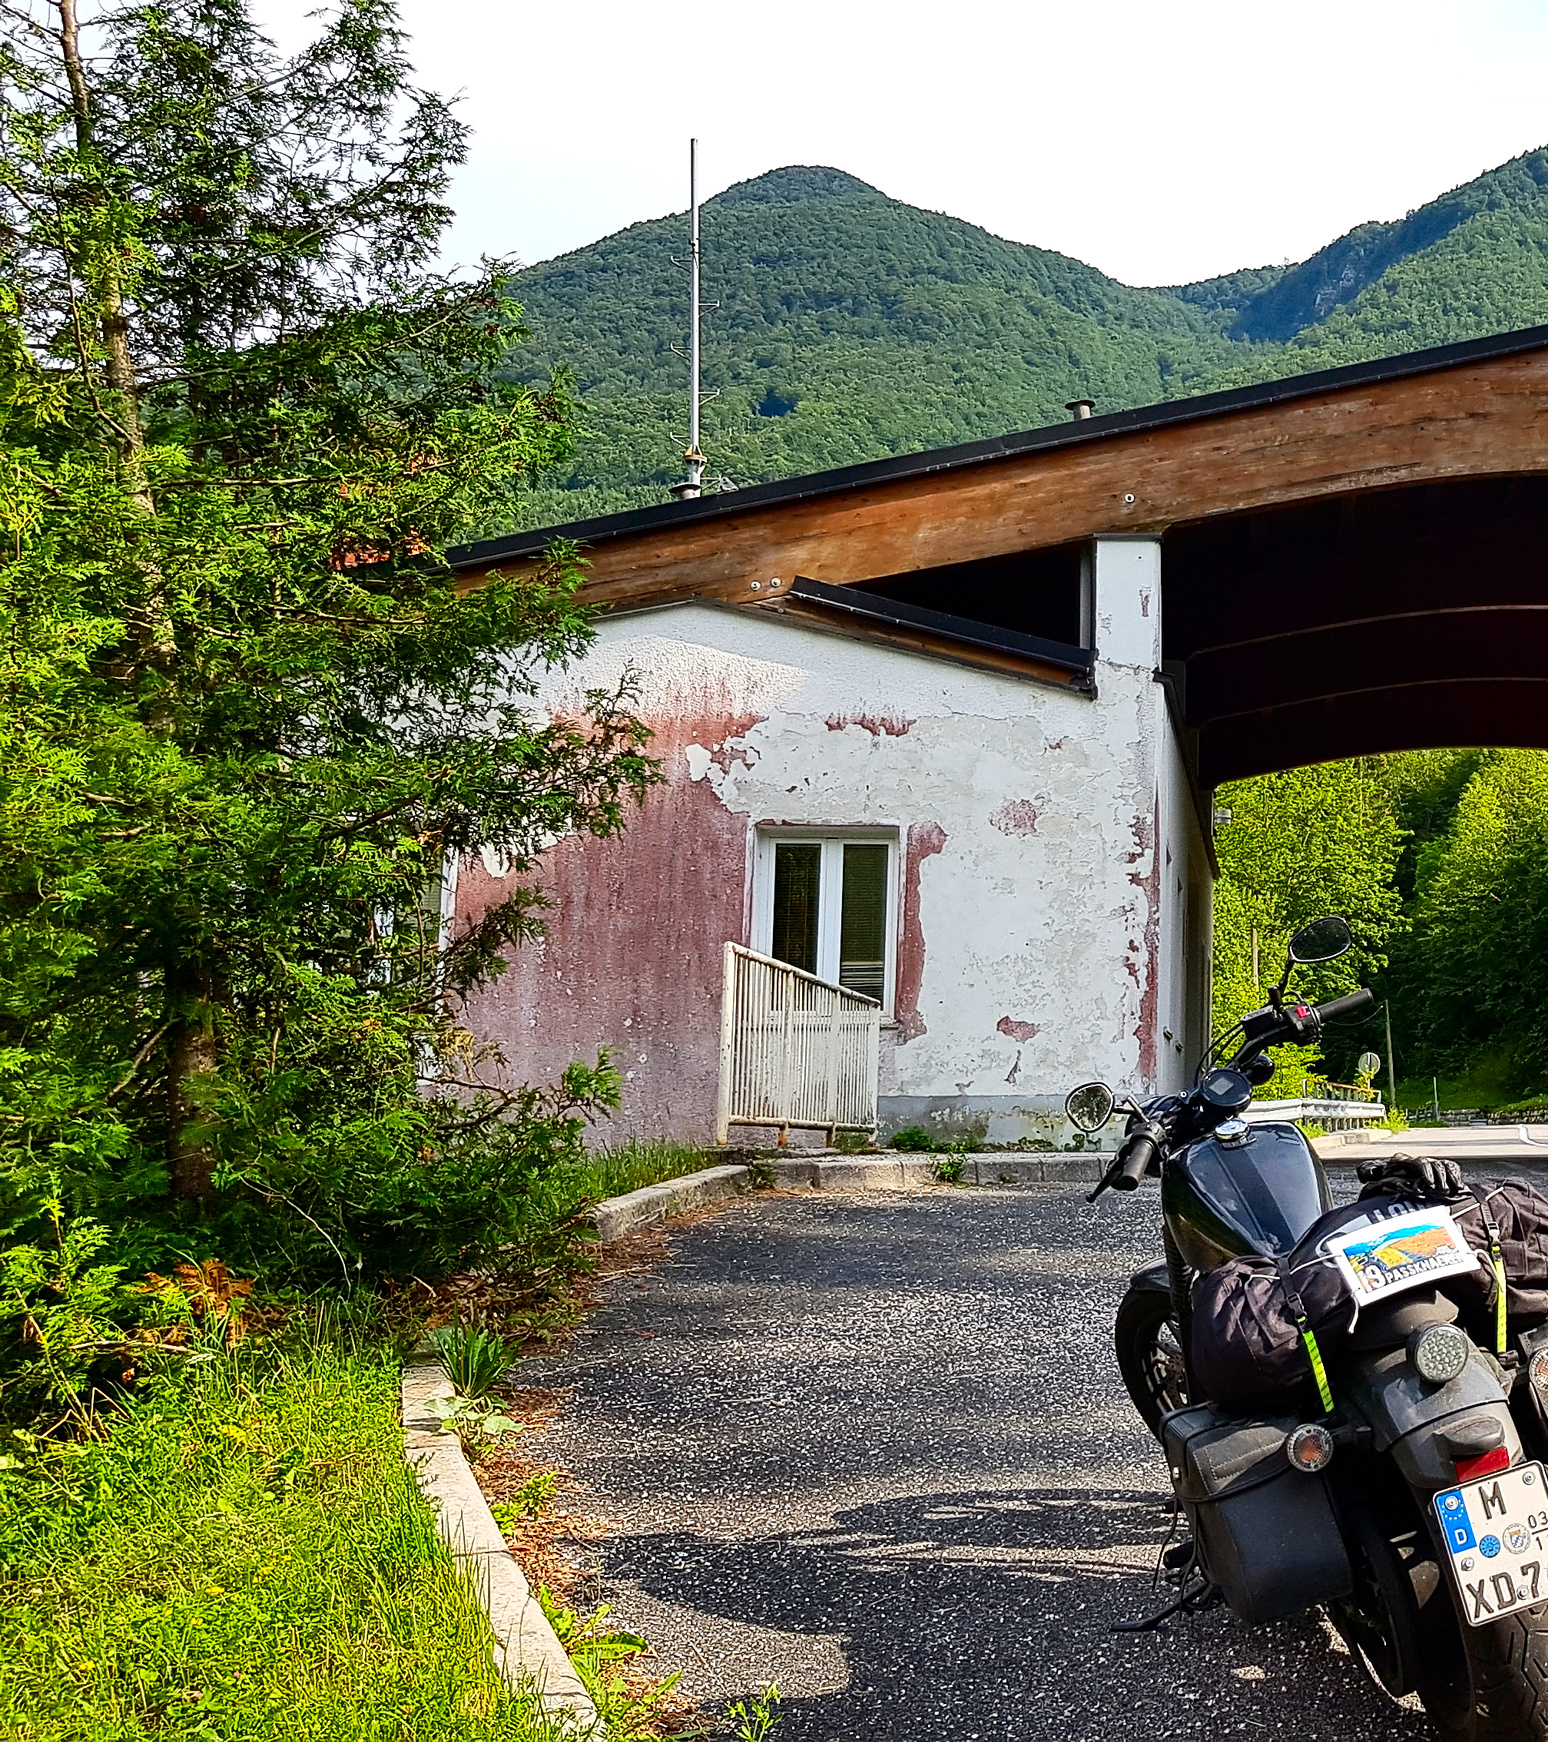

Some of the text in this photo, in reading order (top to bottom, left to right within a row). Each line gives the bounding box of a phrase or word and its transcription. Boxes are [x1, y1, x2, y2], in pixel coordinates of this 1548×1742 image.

[1478, 1481, 1507, 1520] M
[1528, 1511, 1548, 1529] 03
[1454, 1529, 1468, 1545] D
